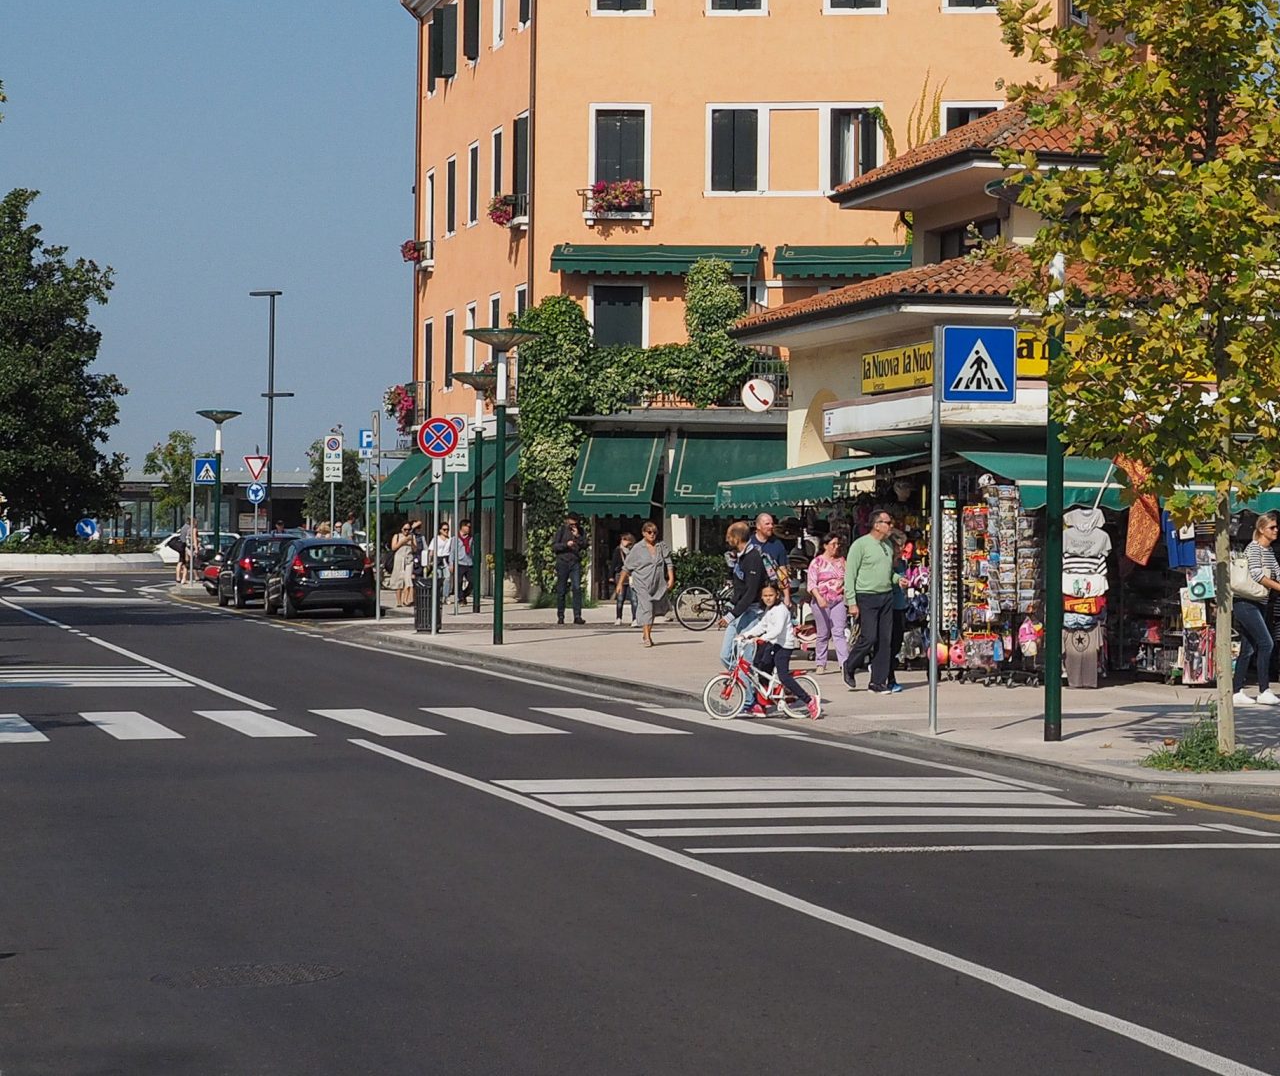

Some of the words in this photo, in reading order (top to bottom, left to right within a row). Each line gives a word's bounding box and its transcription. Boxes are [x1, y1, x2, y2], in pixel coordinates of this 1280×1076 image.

[872, 354, 900, 379] Nuova
[912, 347, 934, 372] Nuo
[362, 431, 373, 447] P
